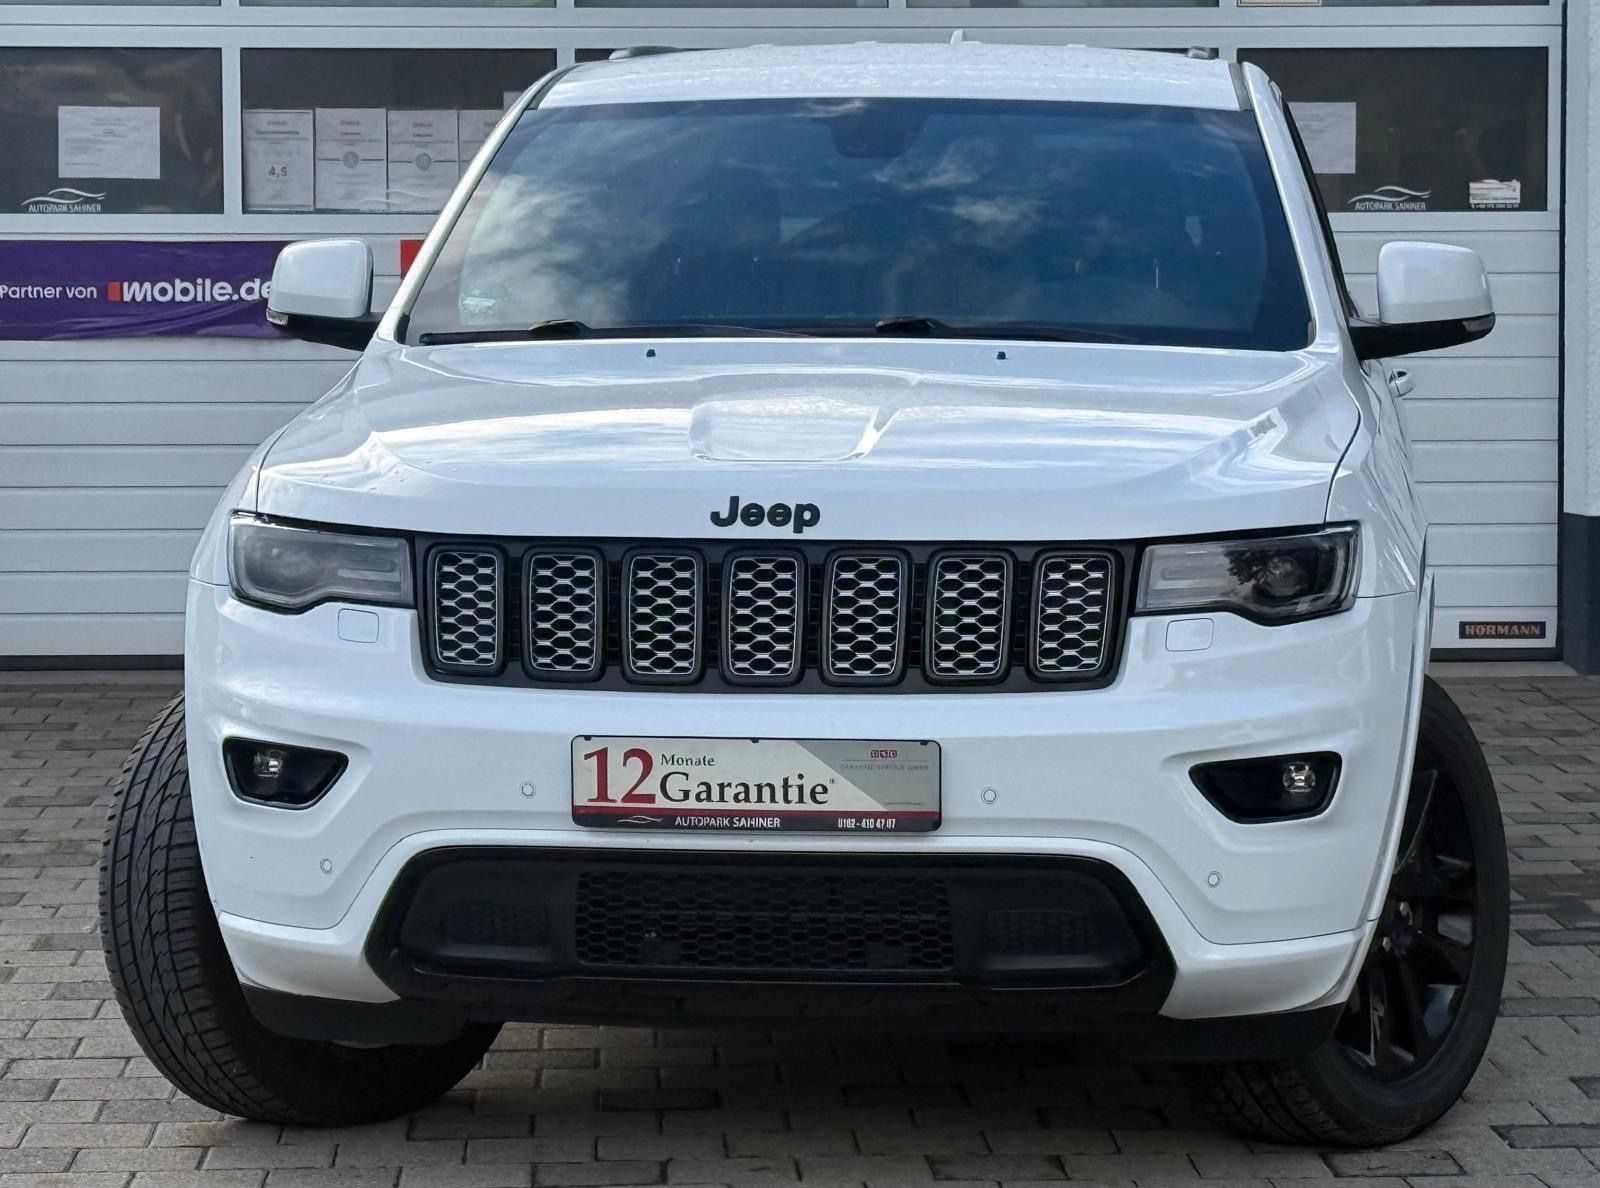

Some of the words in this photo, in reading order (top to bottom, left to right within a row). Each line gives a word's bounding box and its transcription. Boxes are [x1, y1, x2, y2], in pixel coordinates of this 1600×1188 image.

[0, 284, 62, 299] Partner
[68, 286, 97, 299] von
[122, 278, 272, 302] mobile.de
[710, 495, 821, 534] Jeep
[660, 753, 716, 767] Monate
[583, 746, 656, 804] 12
[659, 771, 829, 805] Garantie
[674, 815, 731, 828] AUTOPARK
[732, 816, 781, 828] SAHINER
